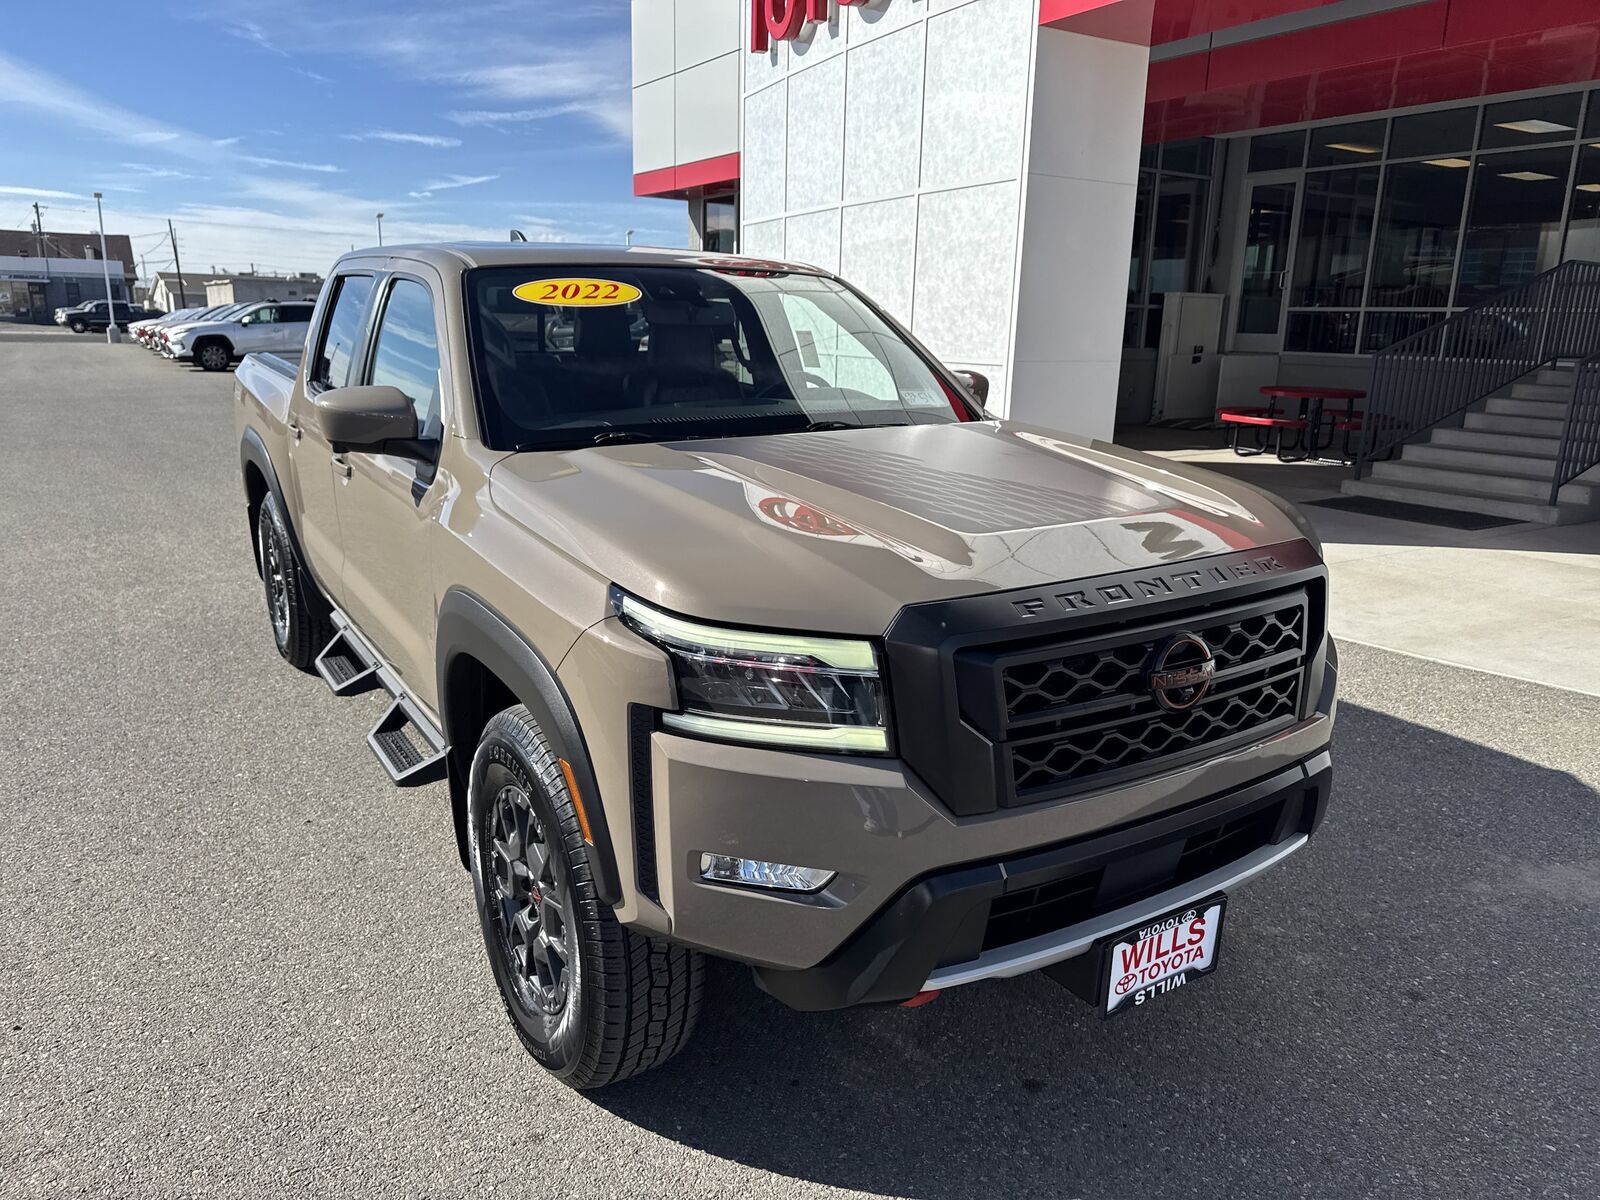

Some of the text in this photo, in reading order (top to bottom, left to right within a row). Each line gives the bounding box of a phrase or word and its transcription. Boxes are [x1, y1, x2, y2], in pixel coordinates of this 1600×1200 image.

[540, 283, 619, 300] 2022
[1010, 556, 1285, 618] FRONTIER
[1152, 663, 1216, 689] NISSAN
[1139, 917, 1180, 939] TOYOTA
[1122, 917, 1206, 974] WILLS
[1139, 946, 1204, 984] TOYOTA
[1135, 972, 1187, 1005] WILLS
